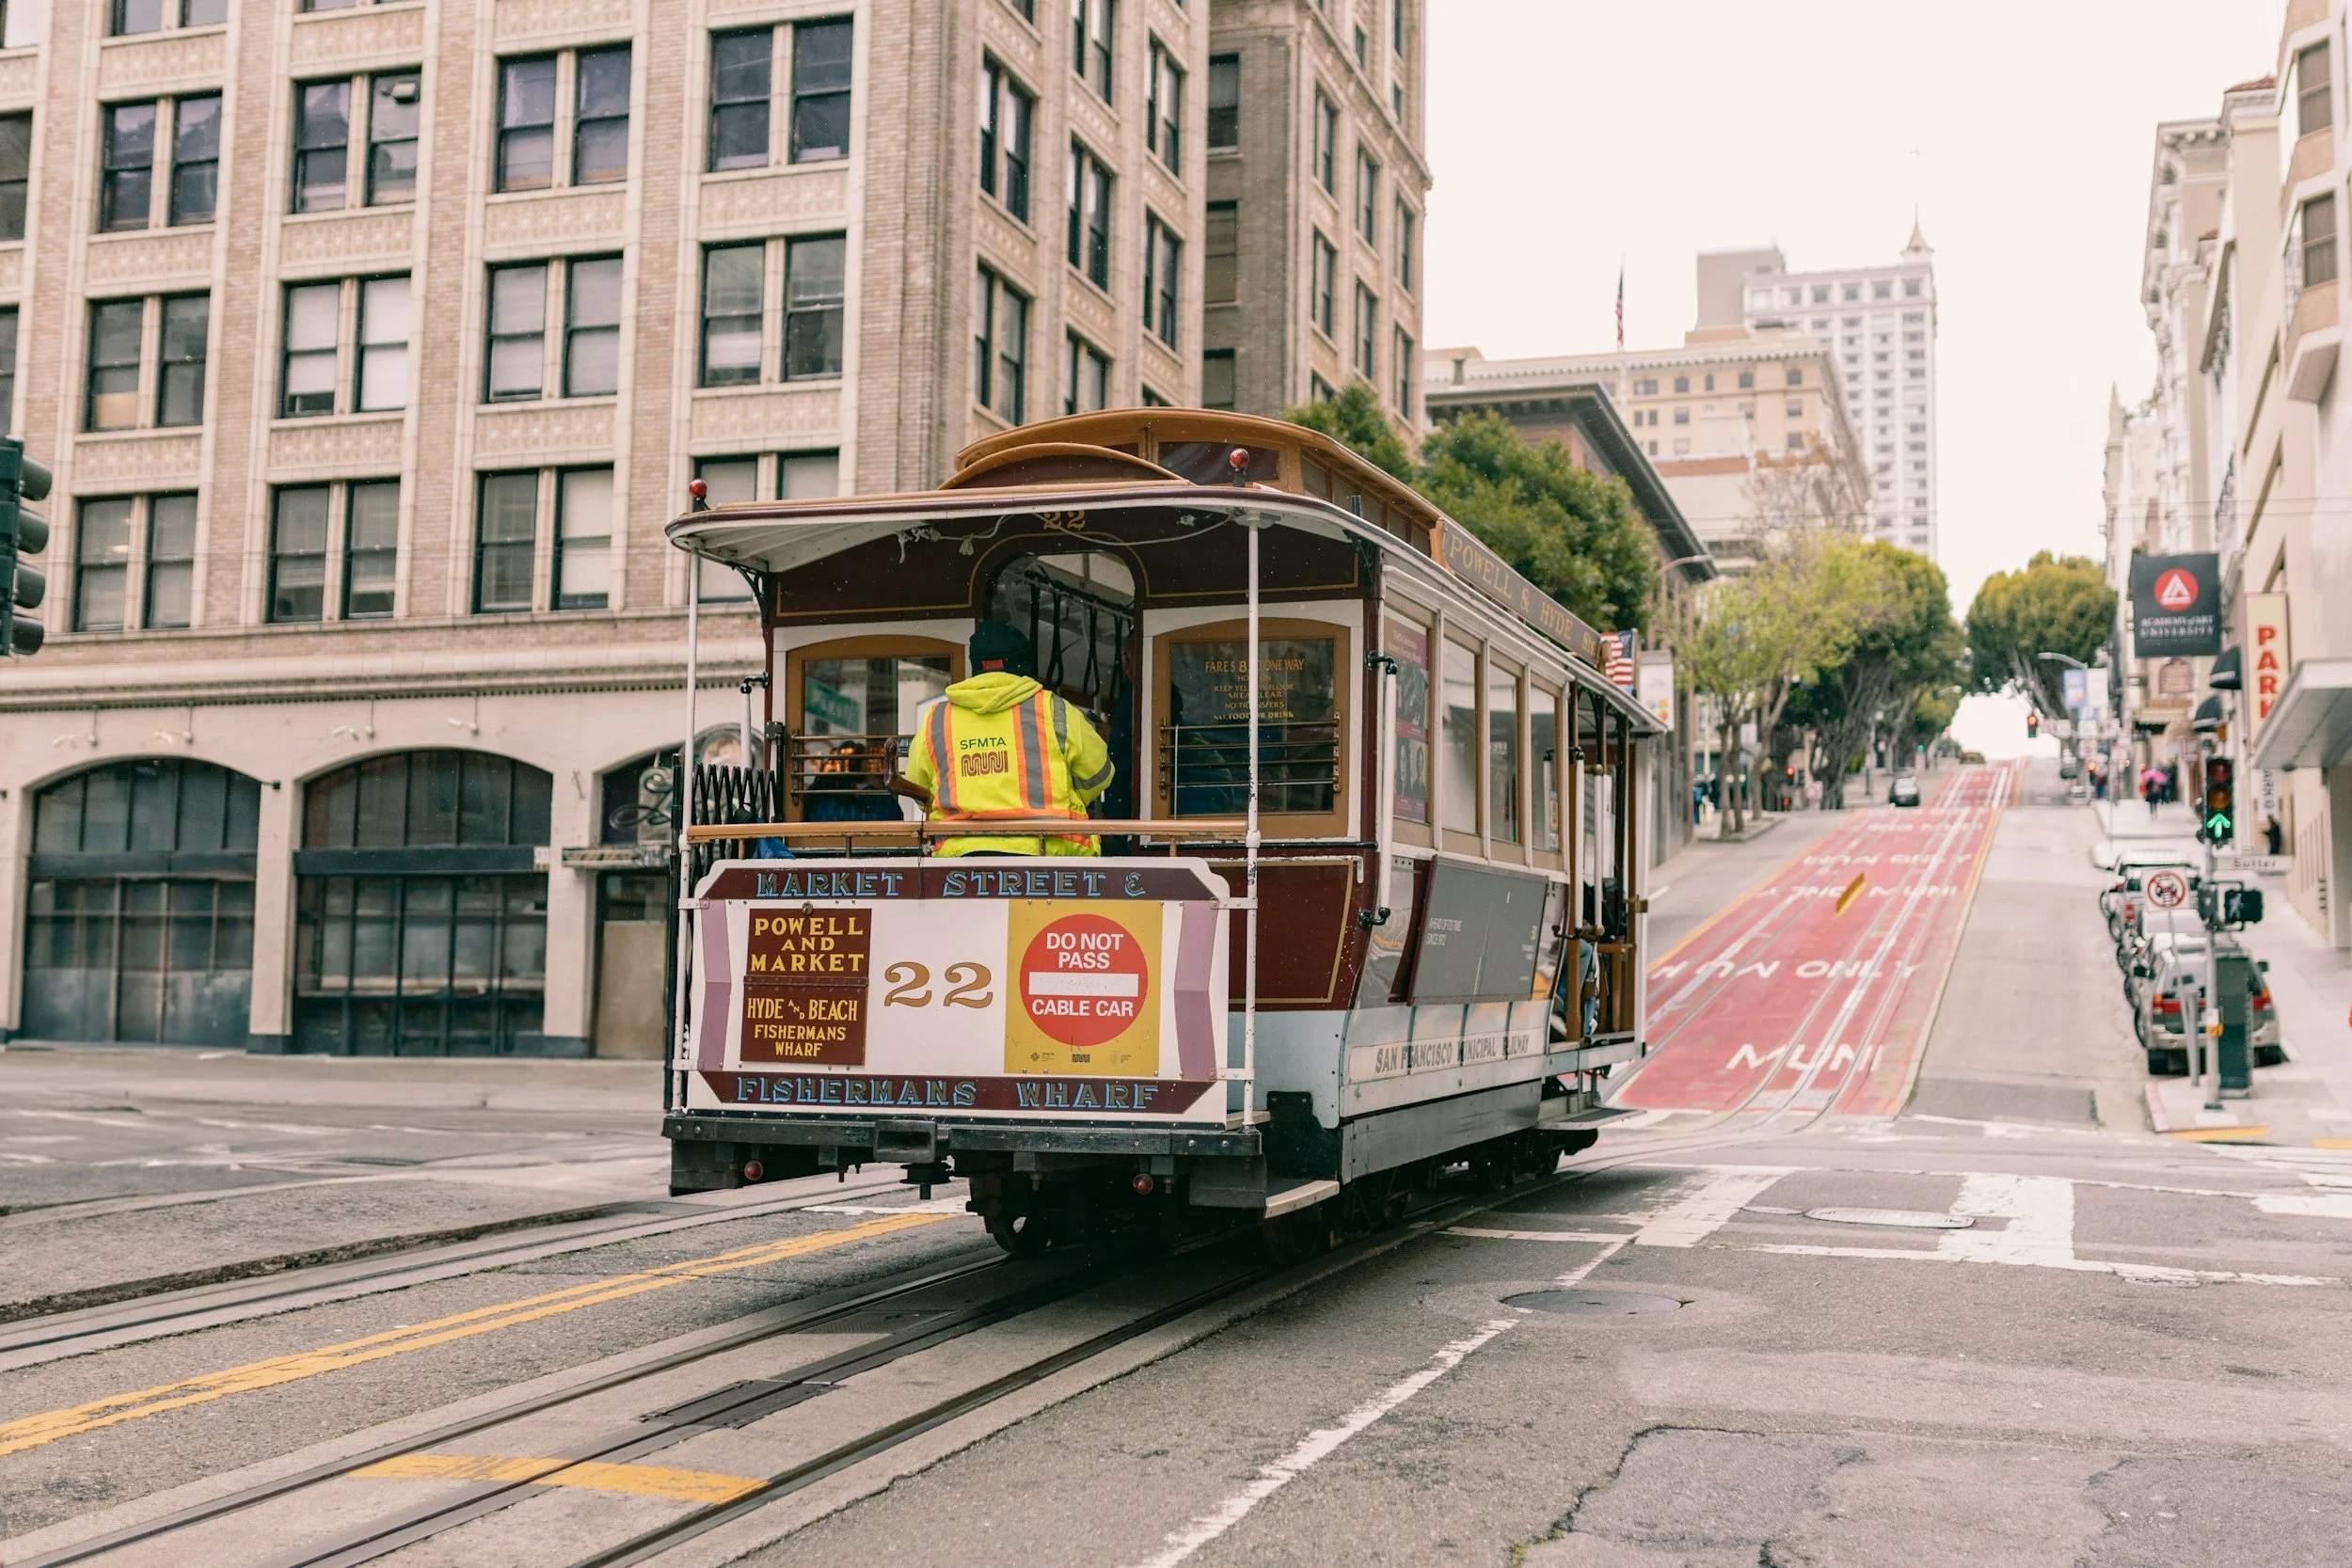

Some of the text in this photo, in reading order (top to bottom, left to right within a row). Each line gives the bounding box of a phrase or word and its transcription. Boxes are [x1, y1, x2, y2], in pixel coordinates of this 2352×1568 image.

[1042, 509, 1086, 530] 22
[1449, 533, 1513, 599] POWELL
[1519, 586, 1531, 613] &
[1539, 601, 1574, 641] HYDE
[2140, 617, 2186, 627] ACADEMY
[2139, 626, 2214, 639] UNIVERSITY
[1263, 659, 1282, 672] ONE
[1284, 659, 1305, 671] WAY
[960, 737, 1006, 749] SFMTA
[755, 871, 903, 897] MARKET
[943, 870, 1106, 897] STREET
[755, 917, 864, 936] POWELL
[781, 937, 834, 951] AND
[1046, 932, 1124, 951] DO NOT
[751, 954, 865, 972] MARKET
[1058, 951, 1110, 970] PASS
[884, 961, 993, 1008] 22
[747, 997, 858, 1022] HYDE AND BEACH
[1032, 998, 1134, 1017] CABLE CAR
[754, 1023, 847, 1041] FISHERMANS
[775, 1041, 823, 1057] WHARF
[1725, 1043, 1885, 1071] MUNI
[1375, 1047, 1398, 1074] SAN
[737, 1076, 1159, 1109] FISHERMANS WHARF
